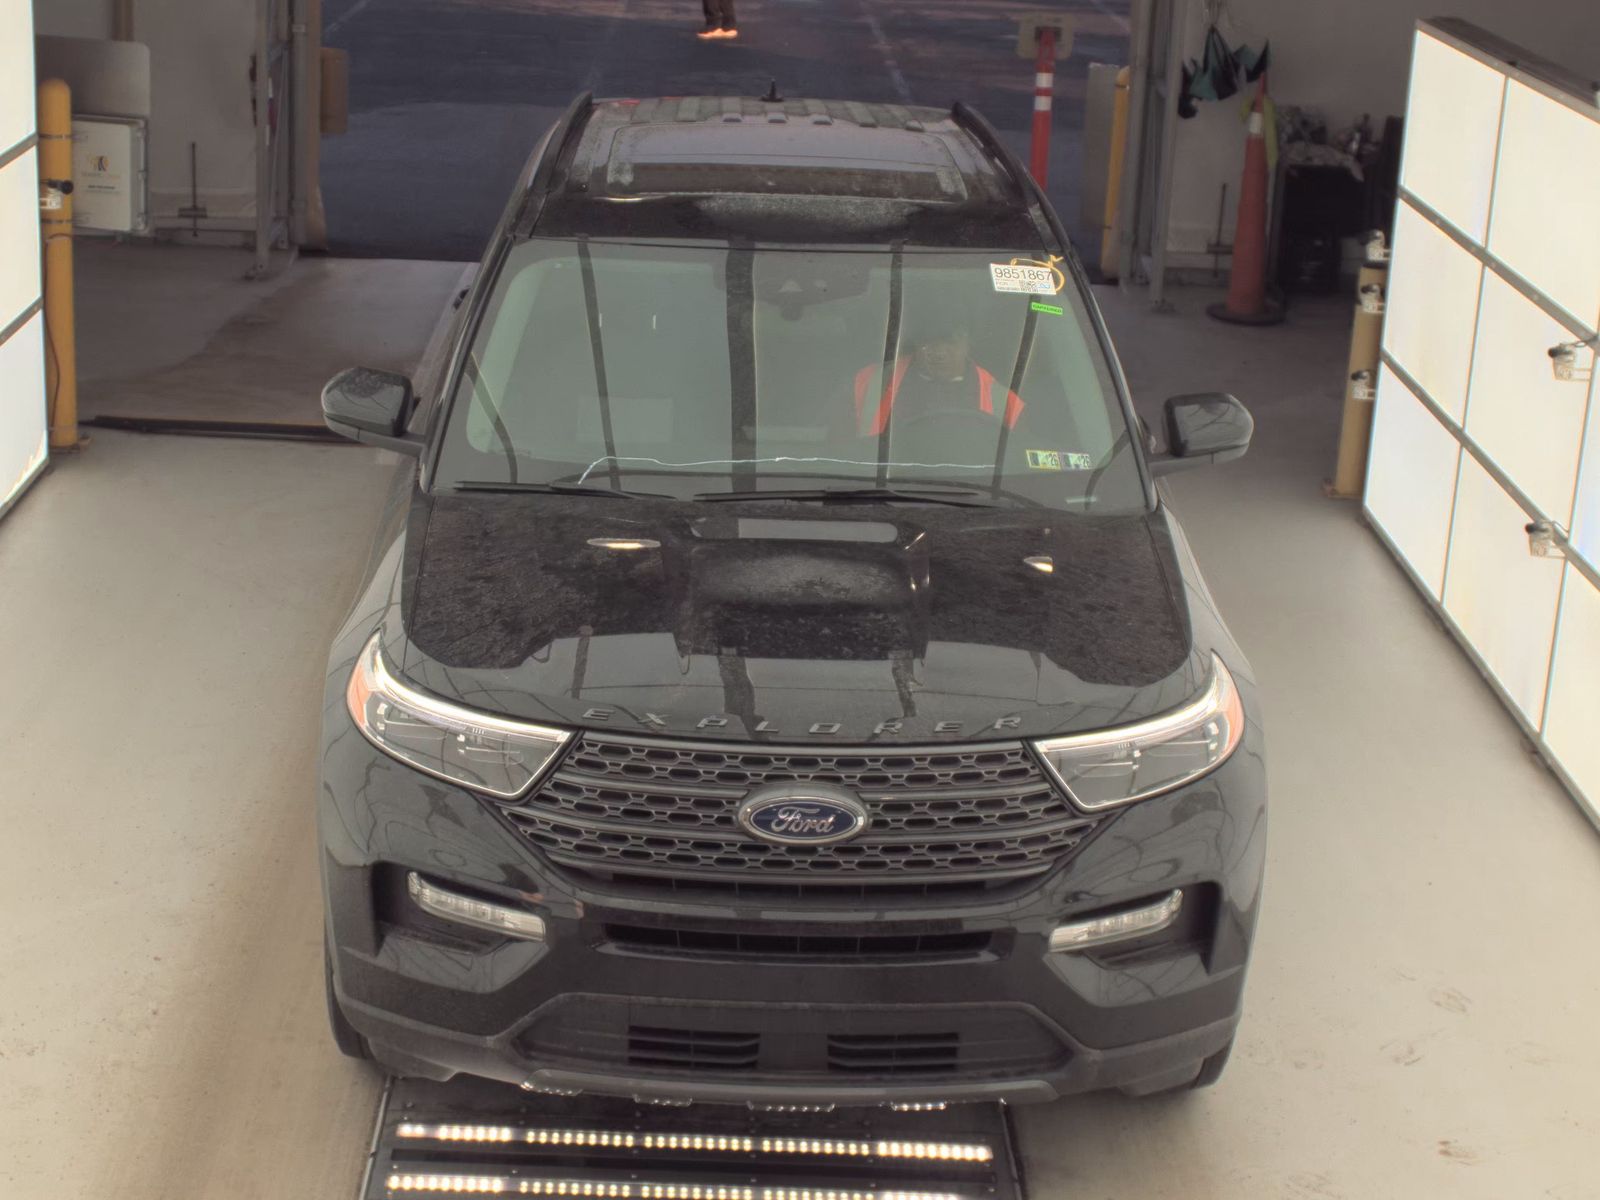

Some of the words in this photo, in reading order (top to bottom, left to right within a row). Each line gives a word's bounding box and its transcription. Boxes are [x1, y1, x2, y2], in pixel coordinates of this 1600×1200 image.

[994, 267, 1053, 281] 9851867
[582, 708, 1021, 734] EXPLORER
[771, 806, 836, 833] Ford
